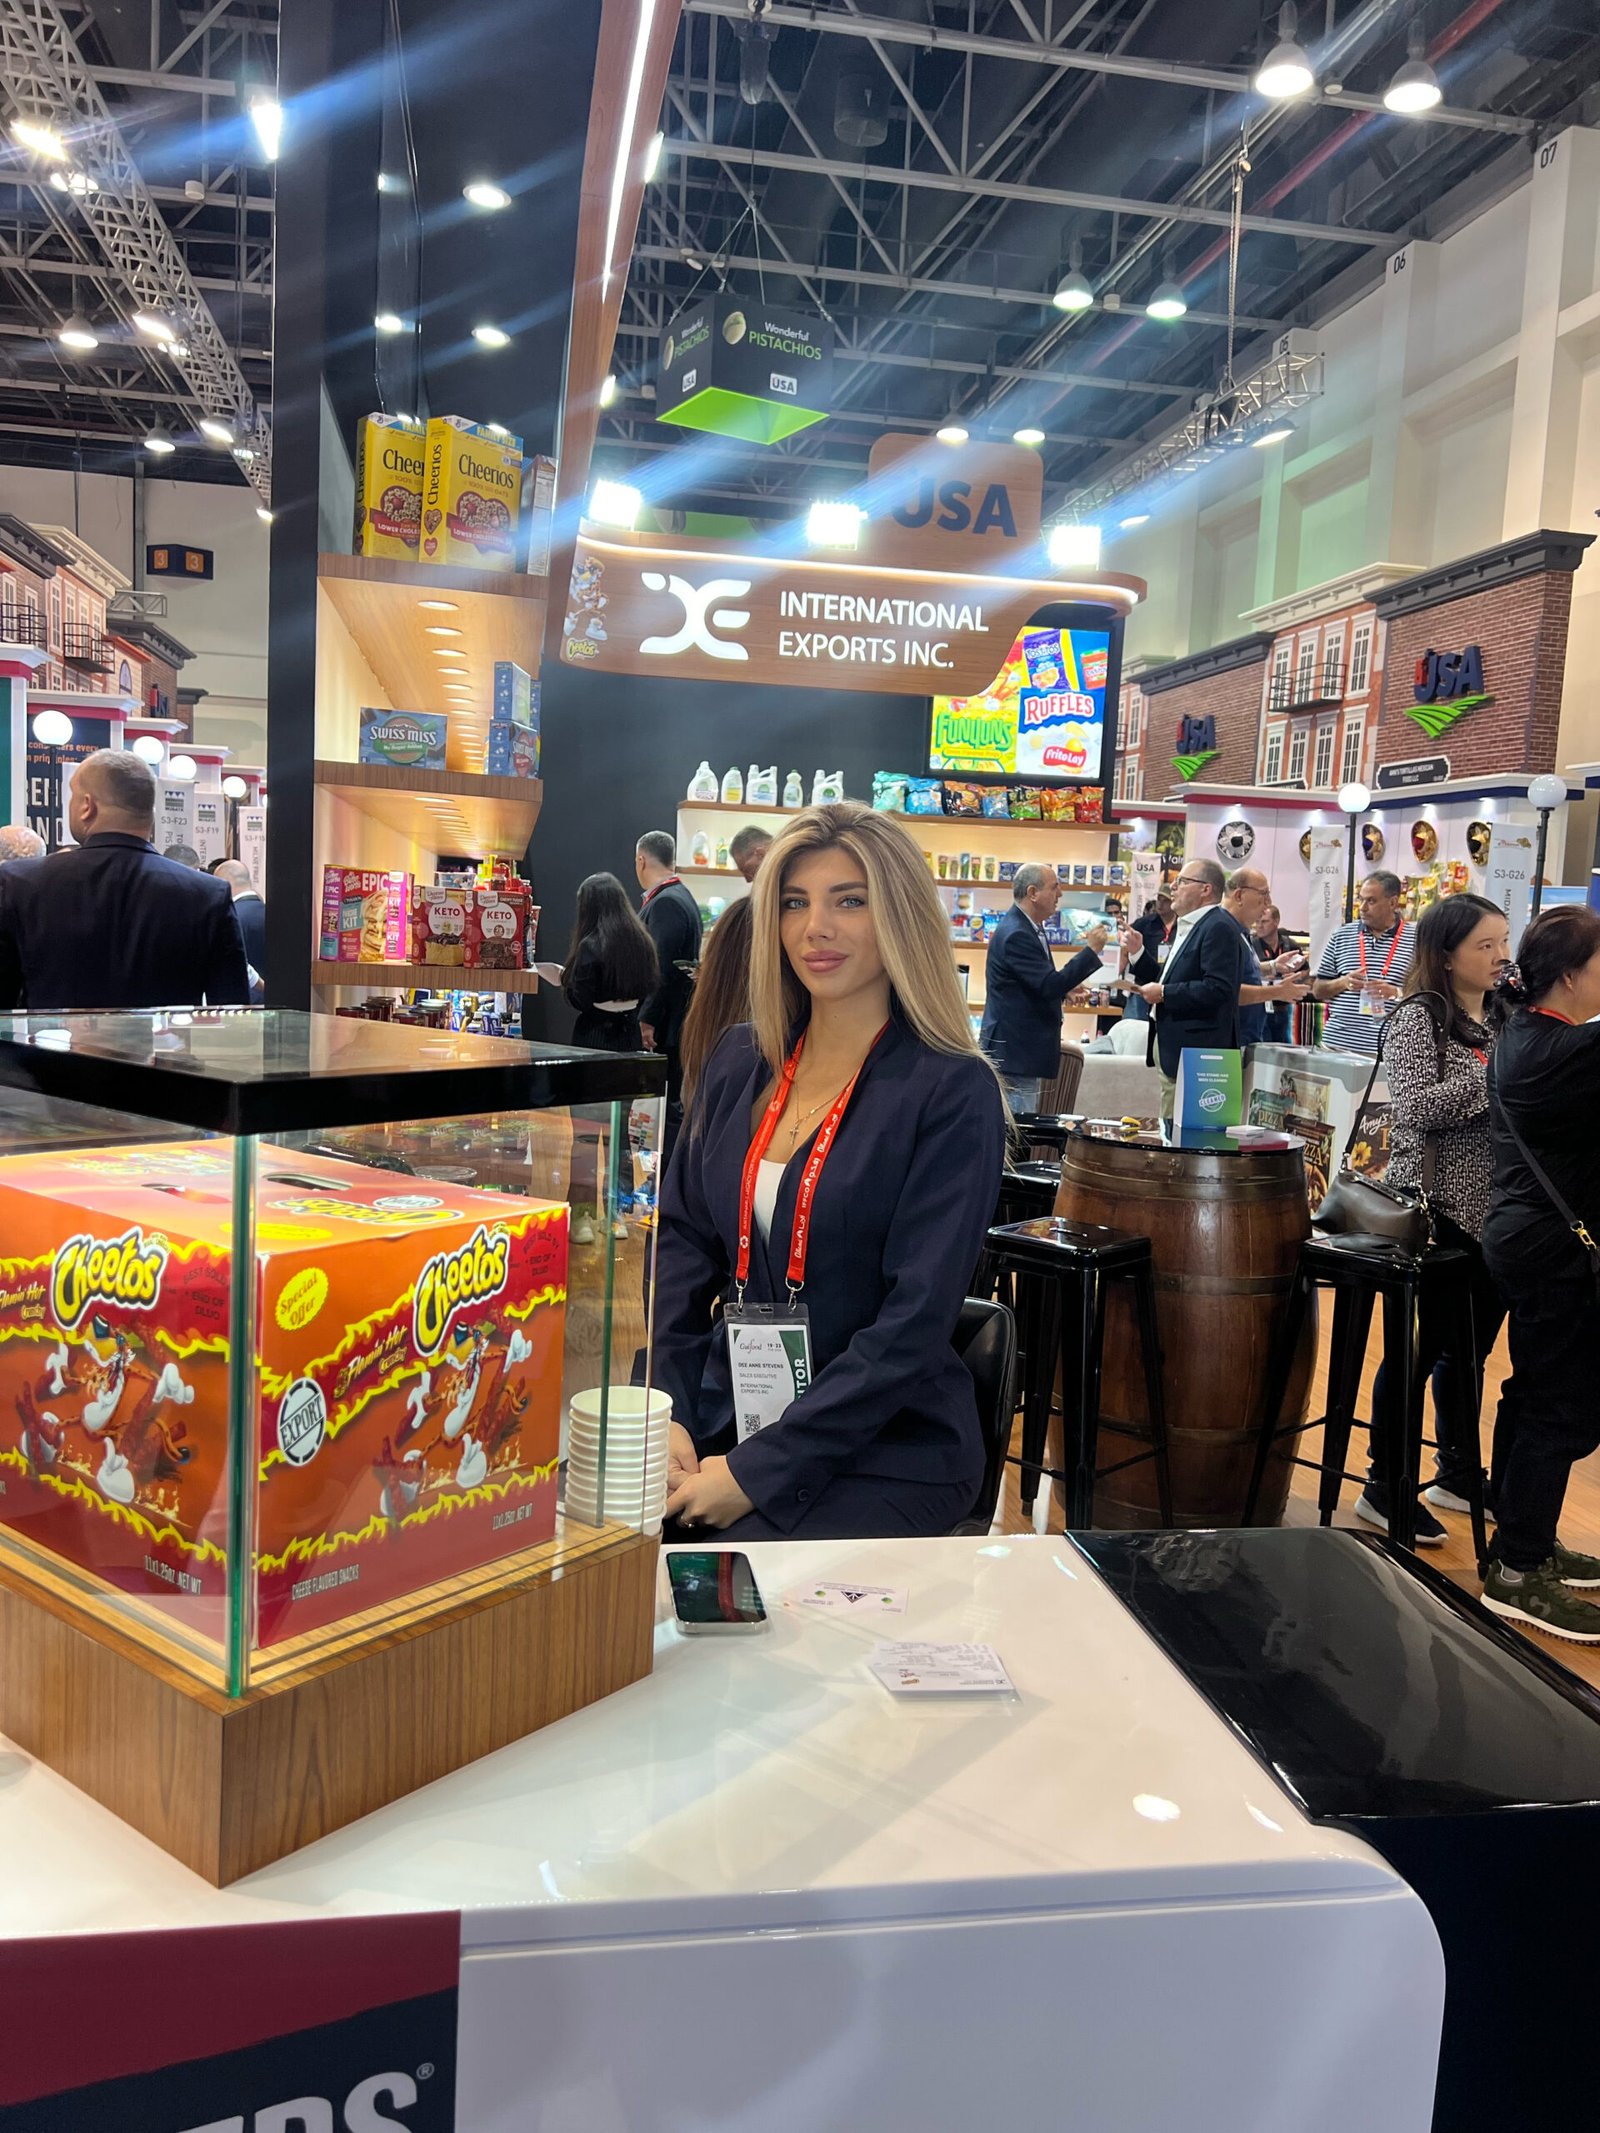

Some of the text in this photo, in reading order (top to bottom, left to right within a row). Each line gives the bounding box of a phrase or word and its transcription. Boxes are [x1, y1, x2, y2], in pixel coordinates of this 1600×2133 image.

[1540, 141, 1558, 169] 07
[1393, 251, 1407, 274] 06
[674, 326, 710, 360] PISTACHIOS
[749, 330, 823, 361] PISTACHIOS
[764, 321, 810, 342] Wonderful
[772, 377, 795, 394] USA
[427, 444, 443, 505] Cheerios
[458, 454, 514, 489] Cheerios
[891, 468, 1018, 538] USA
[779, 590, 990, 632] INTERNATIONAL
[778, 631, 955, 668] EXPORTS INC.
[1414, 643, 1485, 703] USA
[1026, 693, 1096, 723] RUFFLES
[1176, 713, 1217, 754] USA
[160, 816, 188, 826] S3-F23
[1136, 863, 1155, 872] USA
[1315, 865, 1339, 875] S3-G26
[1493, 868, 1526, 881] S3-G26
[362, 872, 389, 892] EPIC
[343, 916, 358, 929] KIT
[434, 906, 460, 917] KETO
[486, 911, 512, 920] KETO
[1199, 1093, 1226, 1107] CLEANED
[1359, 1111, 1390, 1136] Amy's
[801, 1187, 811, 1209] IFFCO
[26, 1281, 46, 1301] Hot
[53, 1231, 165, 1327] Cheetos
[280, 1271, 317, 1315] Special
[415, 1228, 508, 1353] Cheetos
[290, 1297, 316, 1326] Offer
[385, 1324, 408, 1352] Hot
[280, 1396, 323, 1447] EXPORT
[190, 1575, 202, 1595] WT
[292, 1563, 360, 1601] CHEESE FLAVORED SNACKS
